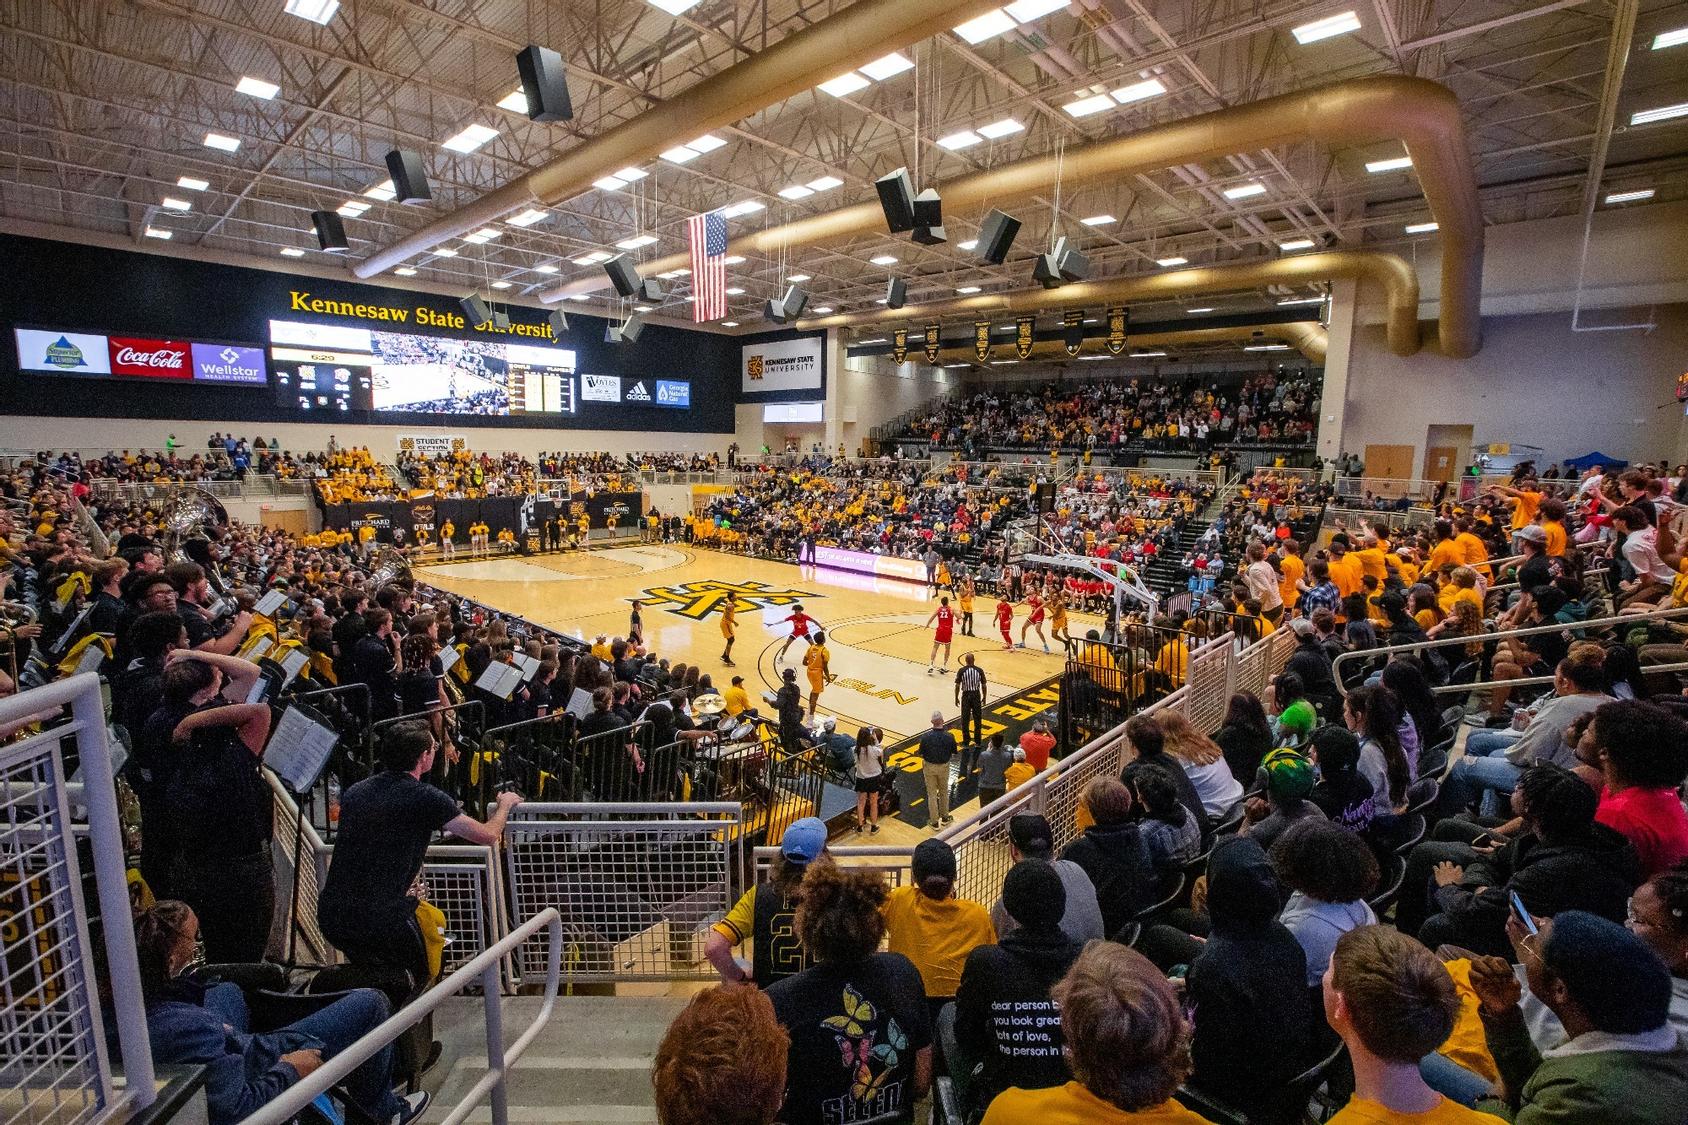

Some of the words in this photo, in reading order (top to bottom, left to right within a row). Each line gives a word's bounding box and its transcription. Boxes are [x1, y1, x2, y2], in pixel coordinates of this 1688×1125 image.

[289, 291, 408, 322] Kennesaw
[415, 306, 465, 329] State
[116, 347, 186, 369] Coca-Cola
[765, 357, 796, 366] KENNESAW
[797, 355, 814, 363] STATE
[201, 363, 259, 377] Wellstar
[765, 363, 814, 374] UNIVERSITY
[626, 393, 652, 402] adidas
[991, 1001, 1012, 1010] dear
[1014, 1002, 1050, 1012] person
[994, 1018, 1009, 1026] you
[1011, 1016, 1033, 1026] look
[996, 1029, 1010, 1040] lots
[1012, 1031, 1024, 1041] of
[1026, 1031, 1051, 1042] love,
[1013, 1047, 1048, 1057] person
[1050, 1046, 1059, 1056] in
